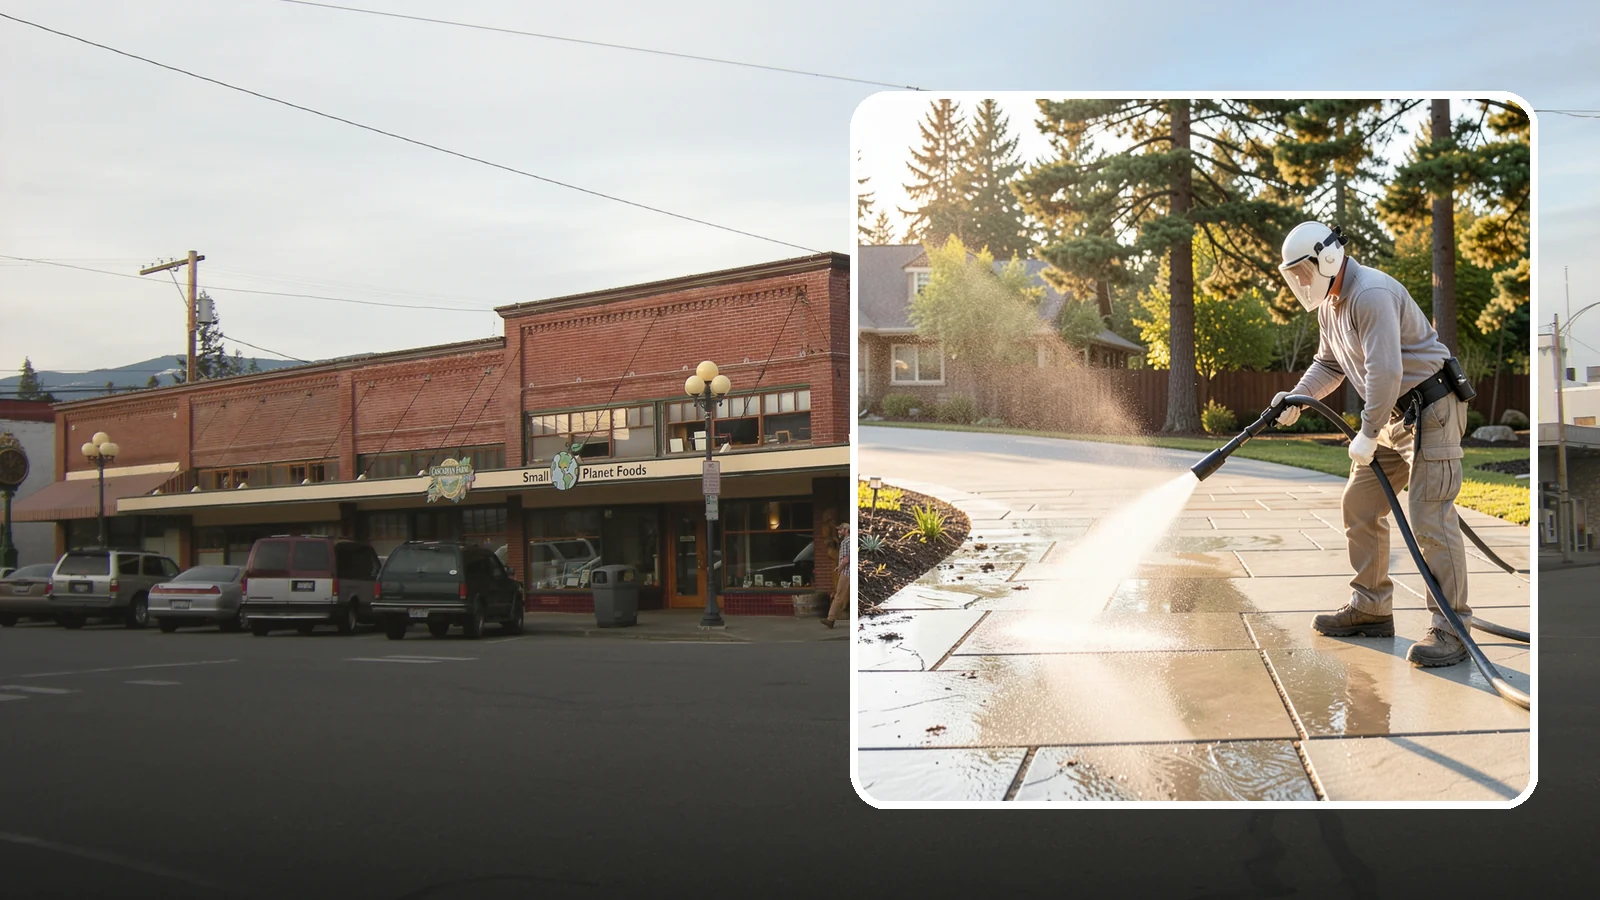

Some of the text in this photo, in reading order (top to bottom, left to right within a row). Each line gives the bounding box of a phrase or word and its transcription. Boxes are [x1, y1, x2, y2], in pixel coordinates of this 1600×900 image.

[431, 467, 456, 475] CASCADIAN
[523, 464, 647, 483] Small Planet Foods
